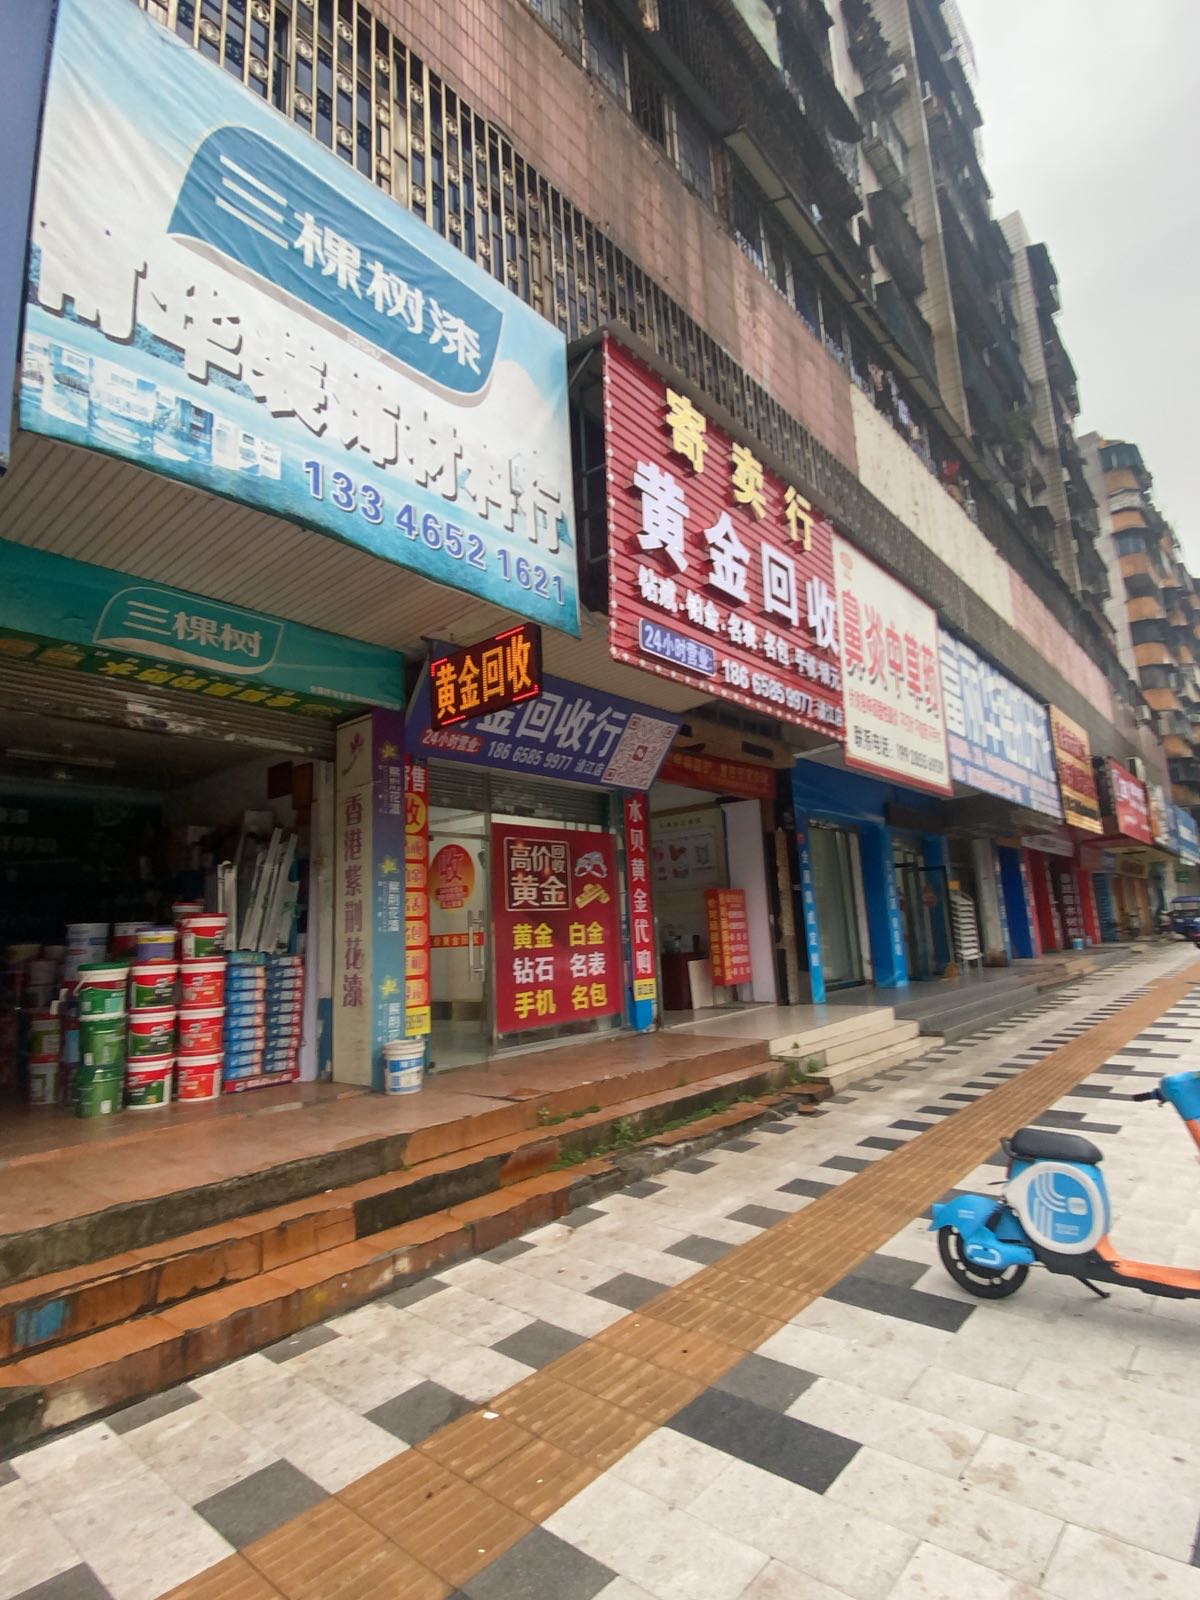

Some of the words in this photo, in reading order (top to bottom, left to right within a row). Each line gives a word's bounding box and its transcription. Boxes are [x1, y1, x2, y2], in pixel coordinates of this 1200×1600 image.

[215, 154, 482, 376] 三棵树漆
[666, 388, 814, 552] 寄卖行
[303, 458, 385, 525] 133
[395, 503, 488, 570] 4652
[496, 547, 567, 605] 1621
[634, 461, 839, 656] 黄金回收
[123, 600, 262, 658] 三棵树
[643, 624, 713, 671] 24小时营业
[435, 634, 532, 719] 黄金回收
[721, 658, 750, 690] 186
[422, 727, 482, 753] 24小时营业
[462, 691, 628, 758] 金回收行
[487, 740, 511, 761] 186
[511, 742, 544, 767] 6585
[543, 751, 573, 771] 9977
[510, 844, 552, 873] 高价
[510, 875, 567, 907] 黄金
[628, 799, 652, 975] 水贝黄金代购
[512, 923, 554, 951] 黄金
[568, 921, 605, 947] 白金
[513, 957, 555, 985] 钻石
[569, 951, 607, 979] 名表
[514, 988, 557, 1020] 手机
[571, 982, 608, 1011] 名包
